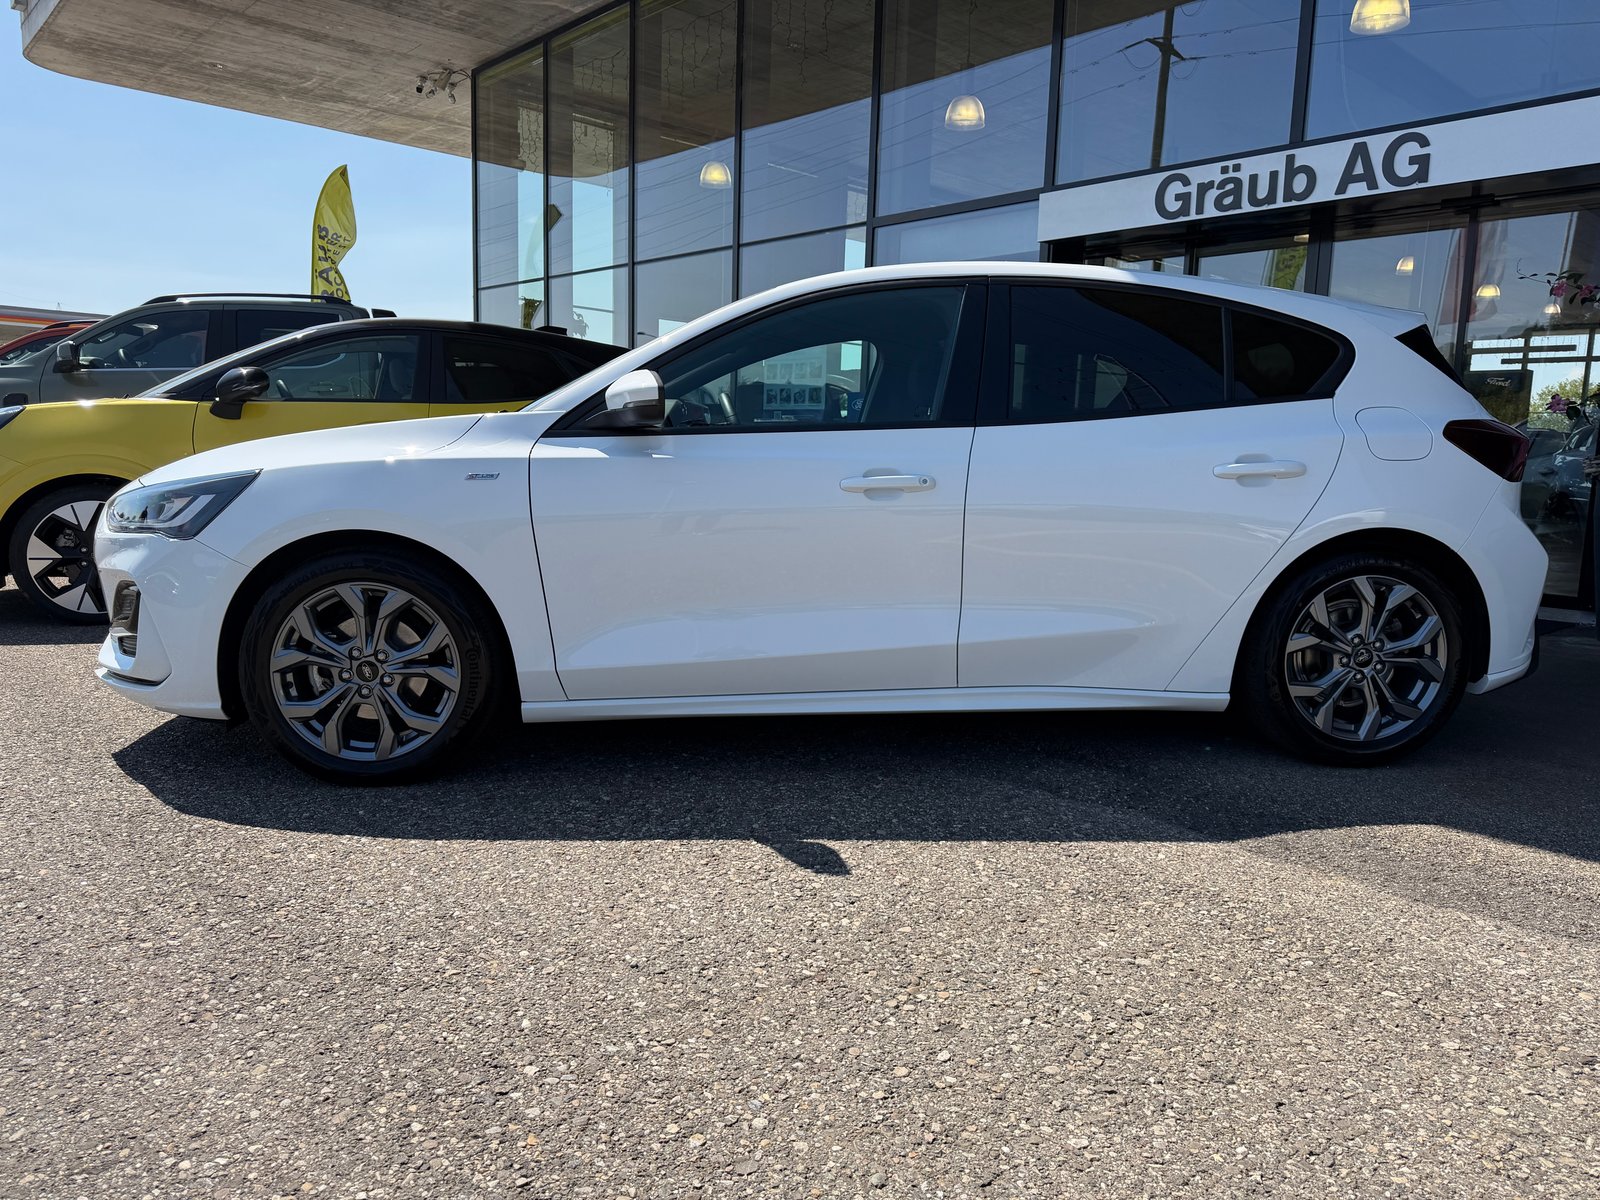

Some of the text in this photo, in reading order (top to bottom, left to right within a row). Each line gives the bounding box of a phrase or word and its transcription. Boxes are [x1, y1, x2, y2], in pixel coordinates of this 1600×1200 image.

[1155, 131, 1431, 220] Gräub AG
[459, 648, 482, 721] Continental
